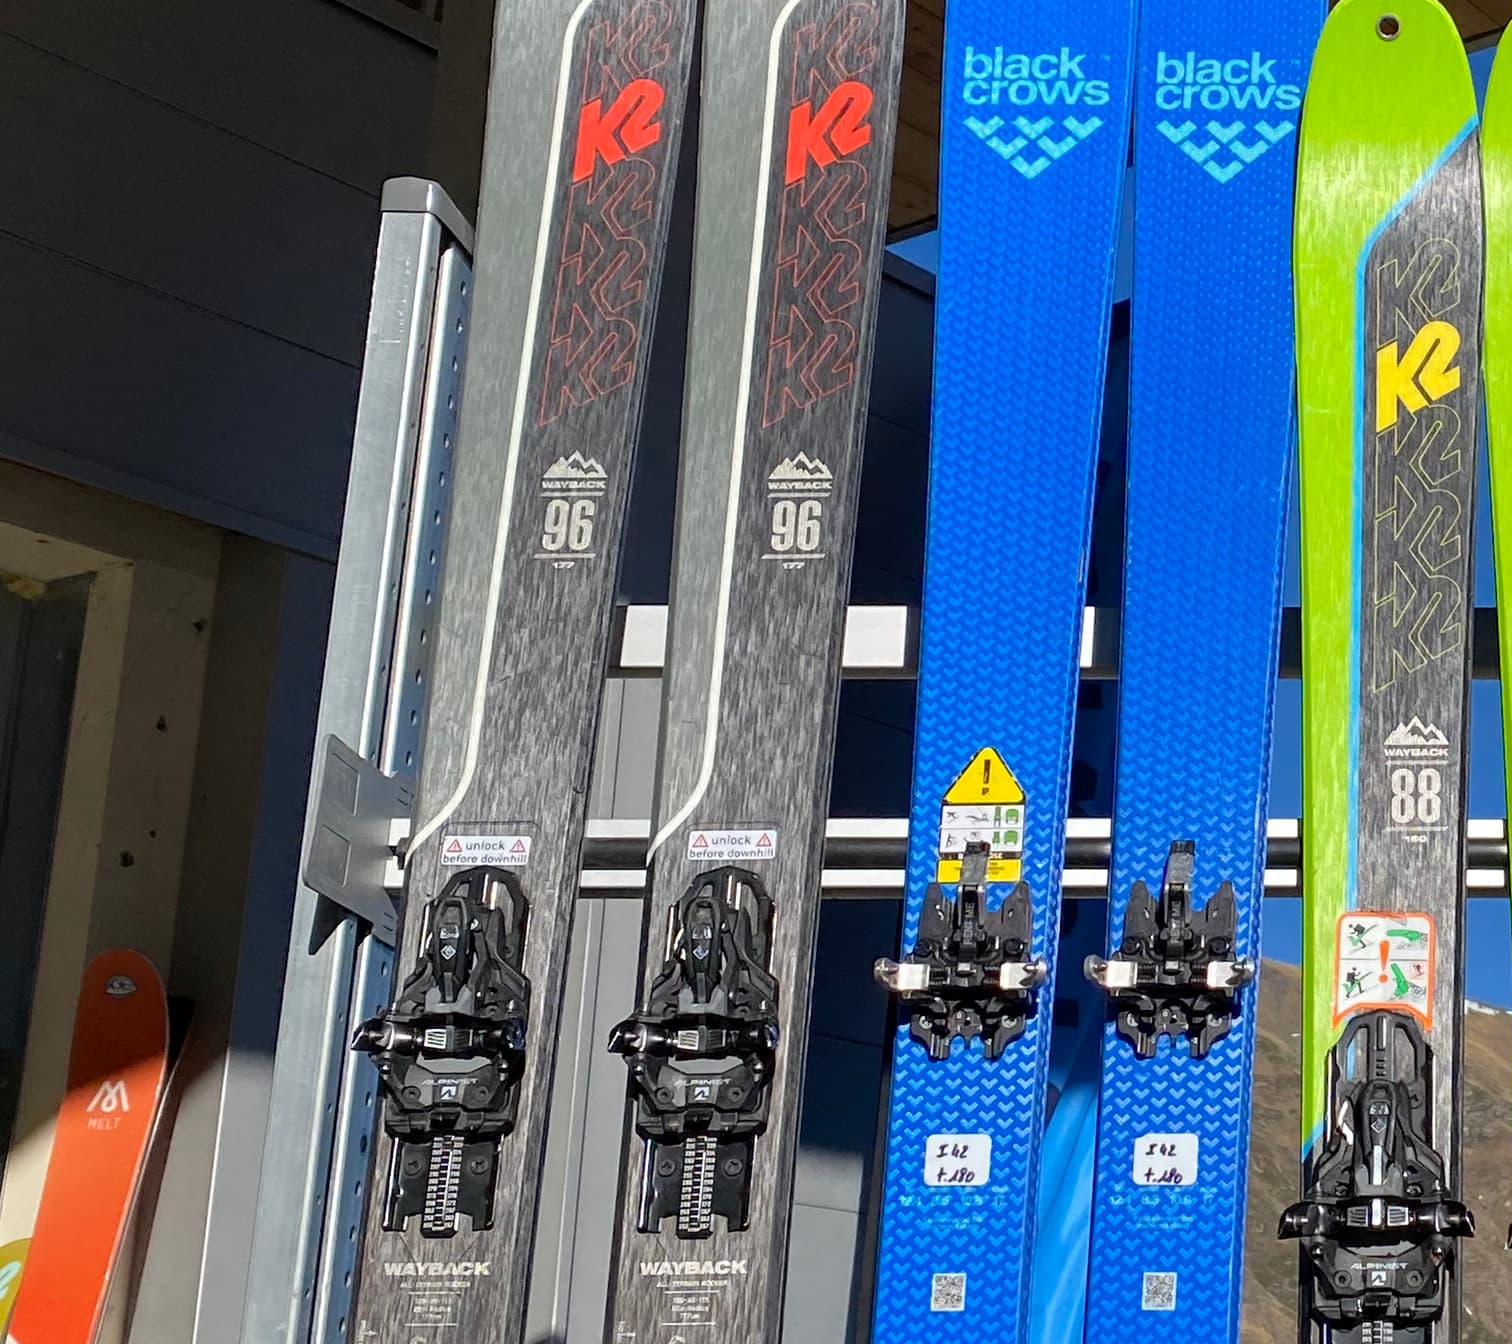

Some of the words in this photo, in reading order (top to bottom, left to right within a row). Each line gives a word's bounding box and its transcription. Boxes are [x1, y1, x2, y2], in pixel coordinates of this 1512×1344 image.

[963, 46, 1084, 79] black
[1157, 51, 1275, 84] black
[963, 74, 1110, 108] crows
[1156, 81, 1300, 110] crows
[572, 79, 665, 184] K2
[784, 81, 873, 184] K2
[1376, 321, 1461, 433] K2
[542, 481, 607, 489] WAYBACK
[767, 481, 832, 490] WAYBACK
[542, 499, 595, 550] 96
[771, 500, 822, 551] 96
[1384, 748, 1449, 757] WAYBACK
[1391, 768, 1442, 824] 88
[466, 840, 505, 852] unlock
[712, 835, 751, 846] unlock
[443, 854, 478, 864] before
[481, 854, 527, 864] downhill
[689, 848, 725, 859] before
[727, 847, 774, 858] downhill
[88, 1118, 121, 1131] MELT
[384, 1261, 492, 1276] WAYBACK
[640, 1260, 747, 1275] WAYBACK
